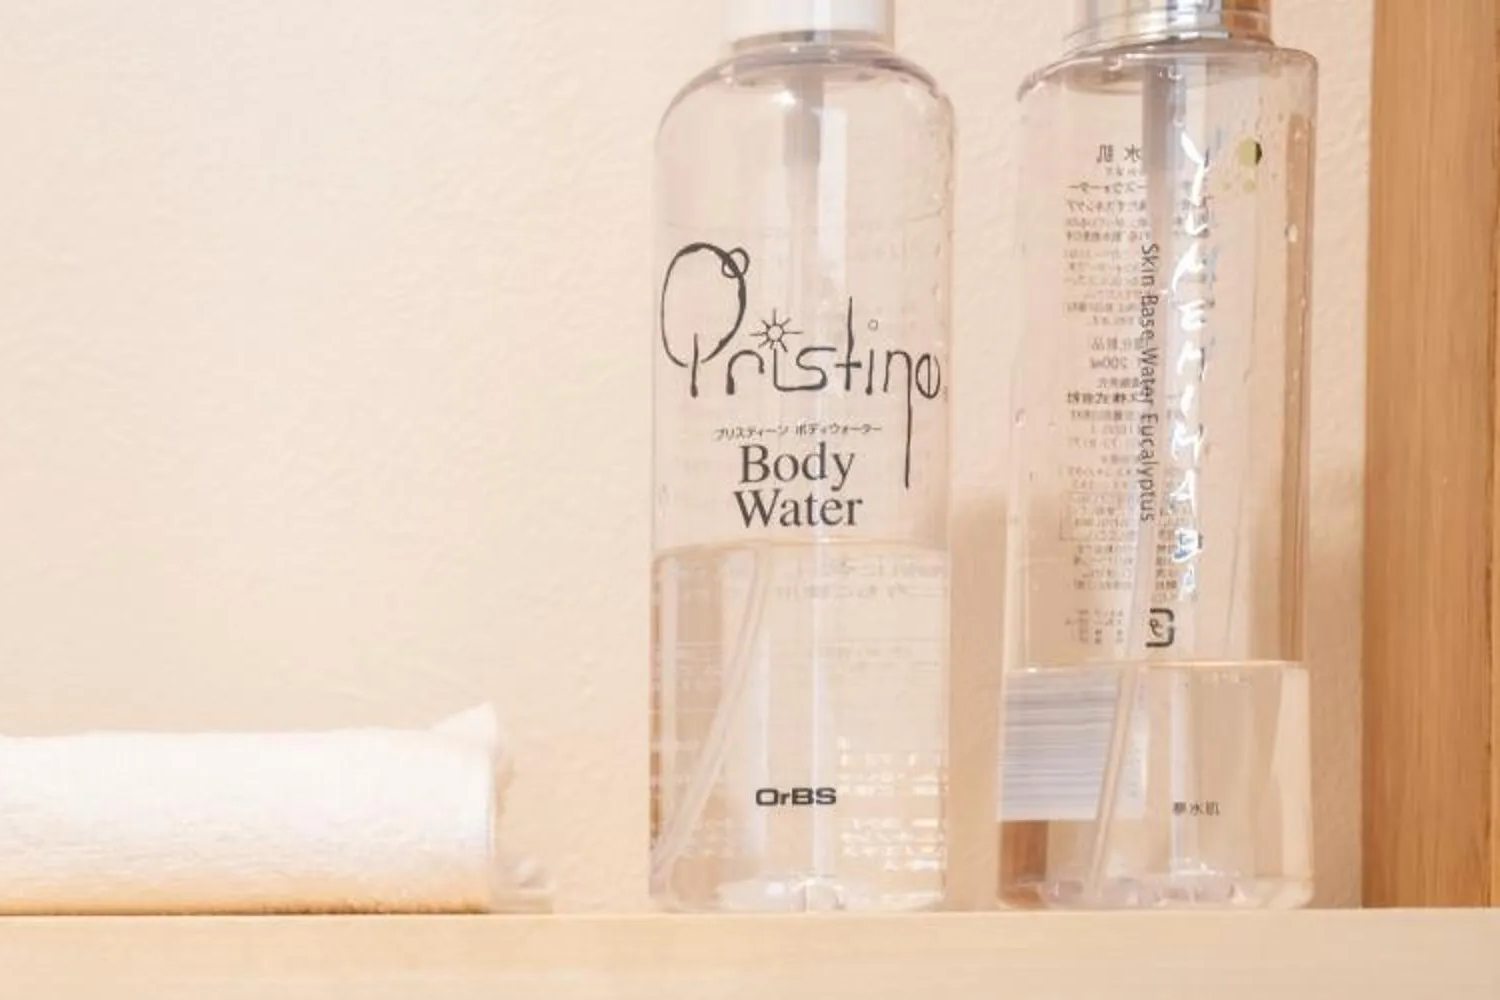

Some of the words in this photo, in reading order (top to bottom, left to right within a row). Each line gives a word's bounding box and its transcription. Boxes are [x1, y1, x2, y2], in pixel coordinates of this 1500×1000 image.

[1140, 243, 1160, 287] Skin
[1140, 295, 1160, 341] Base
[660, 242, 942, 490] Pristine
[1139, 349, 1160, 404] Water
[739, 441, 855, 491] Body
[1136, 413, 1160, 522] Eucalyptus
[733, 489, 864, 528] Water
[755, 787, 837, 806] OrBS
